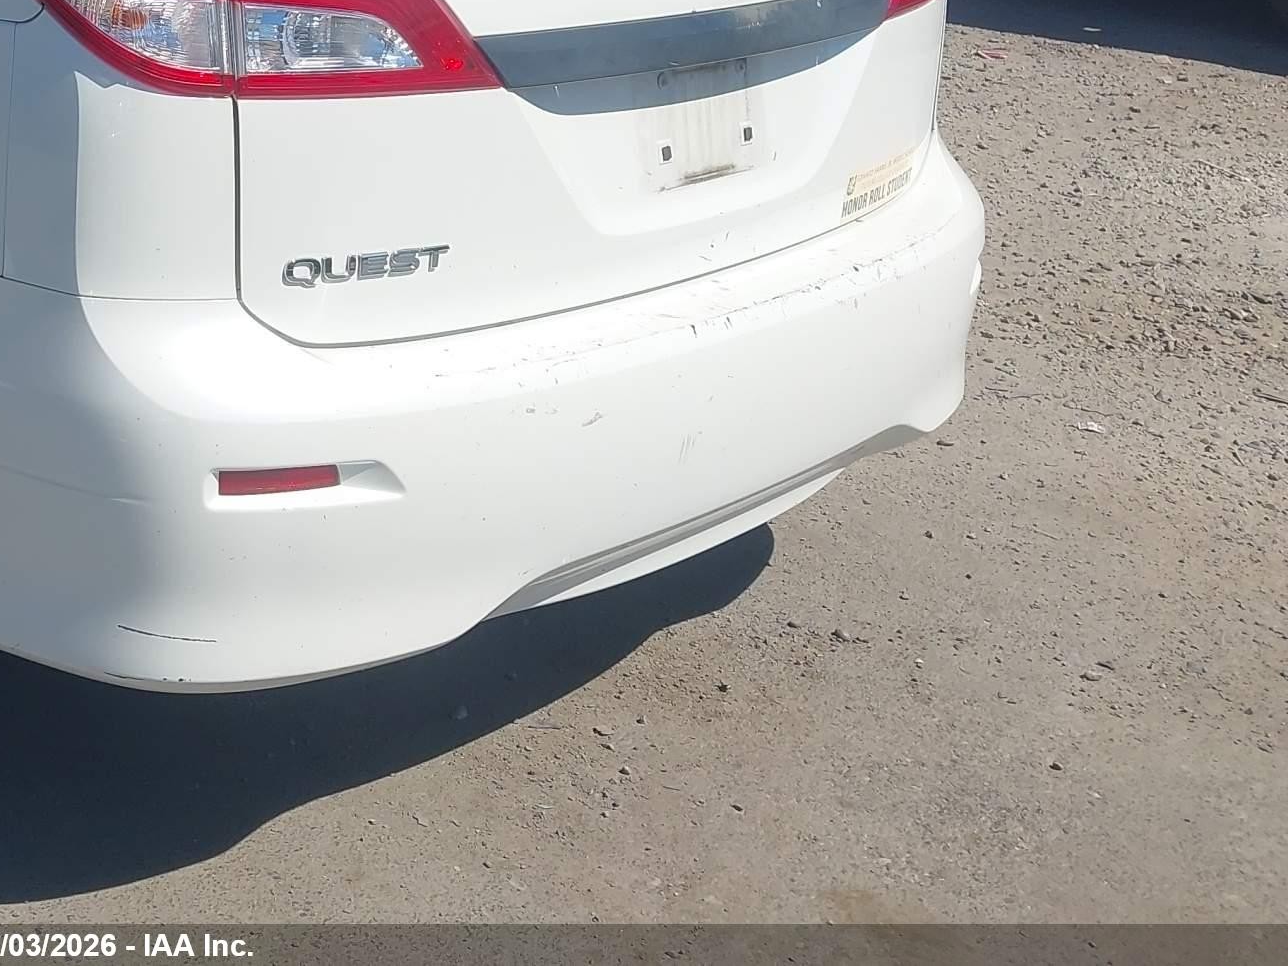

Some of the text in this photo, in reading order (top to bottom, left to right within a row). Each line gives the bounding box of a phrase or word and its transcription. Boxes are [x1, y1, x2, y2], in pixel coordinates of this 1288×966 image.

[841, 192, 868, 218] HONOR
[869, 183, 885, 205] ROLL
[887, 166, 912, 196] STUDENT
[282, 244, 450, 288] QUEST
